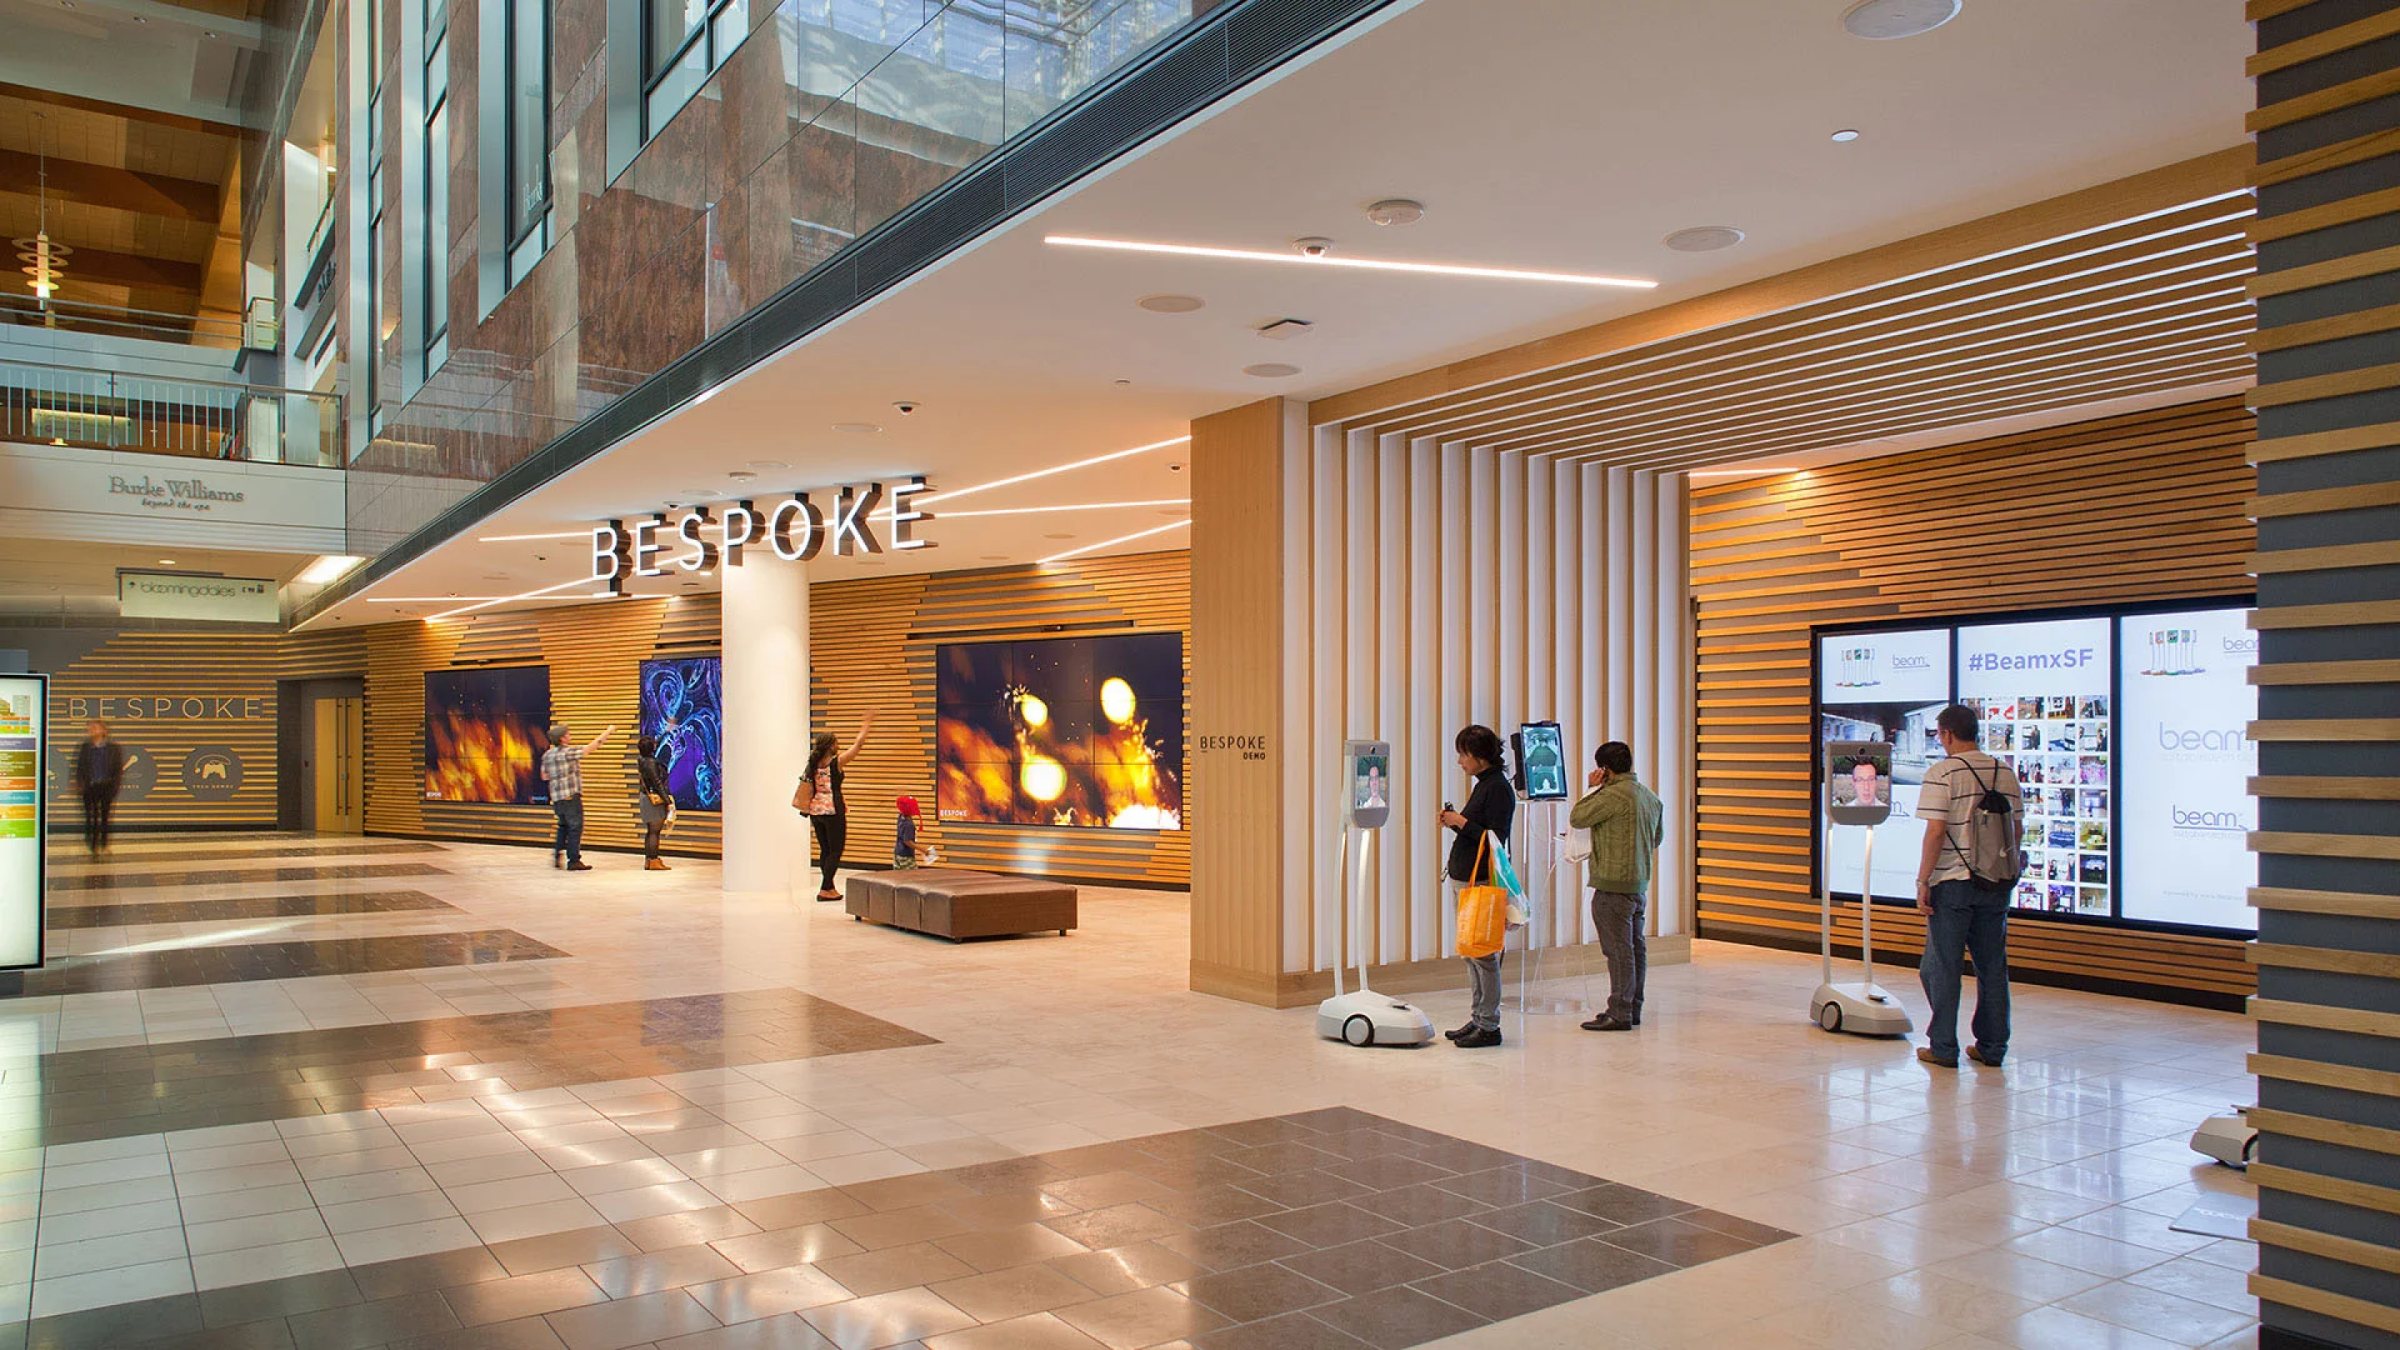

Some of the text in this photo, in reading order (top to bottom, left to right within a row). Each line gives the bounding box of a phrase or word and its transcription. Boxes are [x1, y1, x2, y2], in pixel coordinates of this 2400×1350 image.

[109, 475, 245, 502] Burke Williams
[592, 482, 936, 583] BESPOKE
[2224, 636, 2258, 651] bea
[1892, 654, 1925, 666] beam
[1968, 648, 2094, 672] #BeamxSF
[69, 697, 261, 720] BESPOKE
[1199, 735, 1266, 750] BESPOKE
[1242, 751, 1266, 761] DEMO
[2172, 804, 2237, 827] beam
